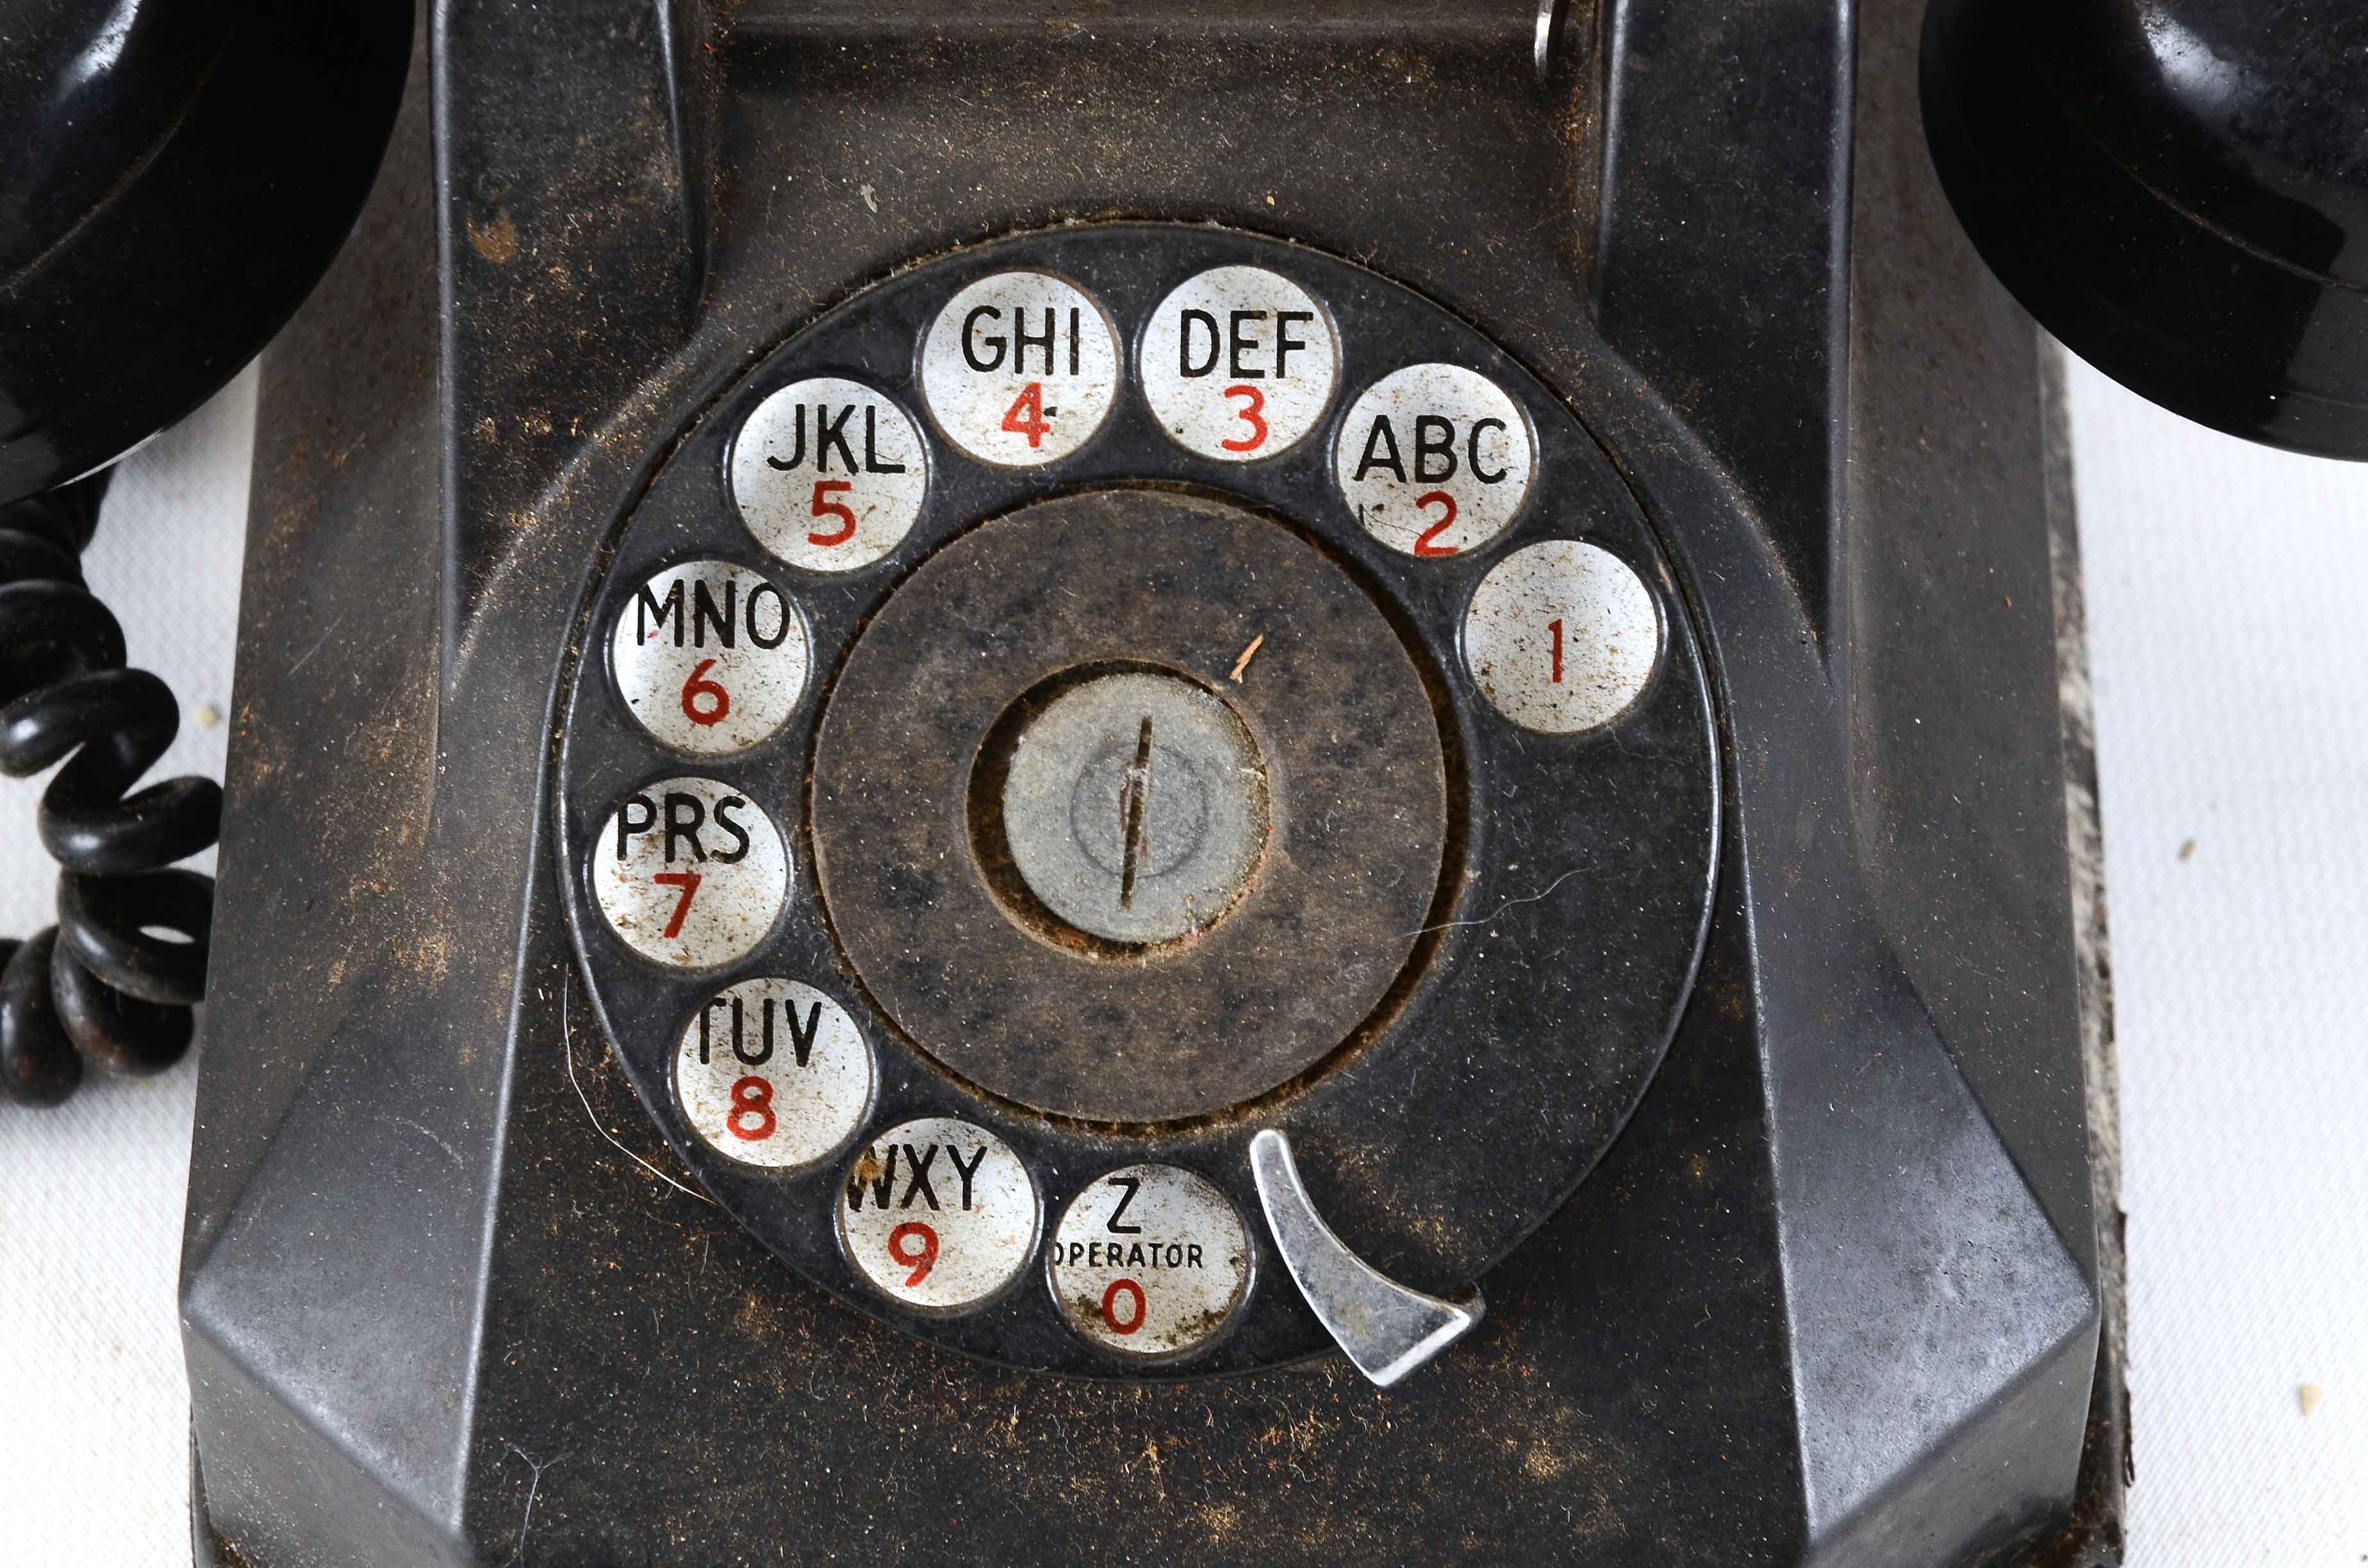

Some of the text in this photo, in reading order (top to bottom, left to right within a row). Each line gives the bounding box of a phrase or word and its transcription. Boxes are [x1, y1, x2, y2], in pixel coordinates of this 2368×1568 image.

[962, 306, 1079, 375] GHI
[1180, 309, 1313, 378] DEF
[767, 404, 905, 473] JKL
[1001, 382, 1050, 447] 4
[1221, 385, 1269, 452] 3
[1354, 415, 1508, 484] ABC
[808, 481, 857, 546] 5
[1414, 491, 1458, 555] 2
[637, 580, 790, 649] MNO
[1548, 618, 1562, 683] 1
[681, 659, 730, 725] 6
[617, 793, 750, 863] PRS
[654, 874, 702, 938] 7
[700, 998, 822, 1067] TUV
[727, 1076, 777, 1141] 8
[846, 1144, 987, 1212] WXY
[1106, 1177, 1142, 1234] Z
[887, 1221, 939, 1287] 9
[1101, 1278, 1147, 1335] 0
